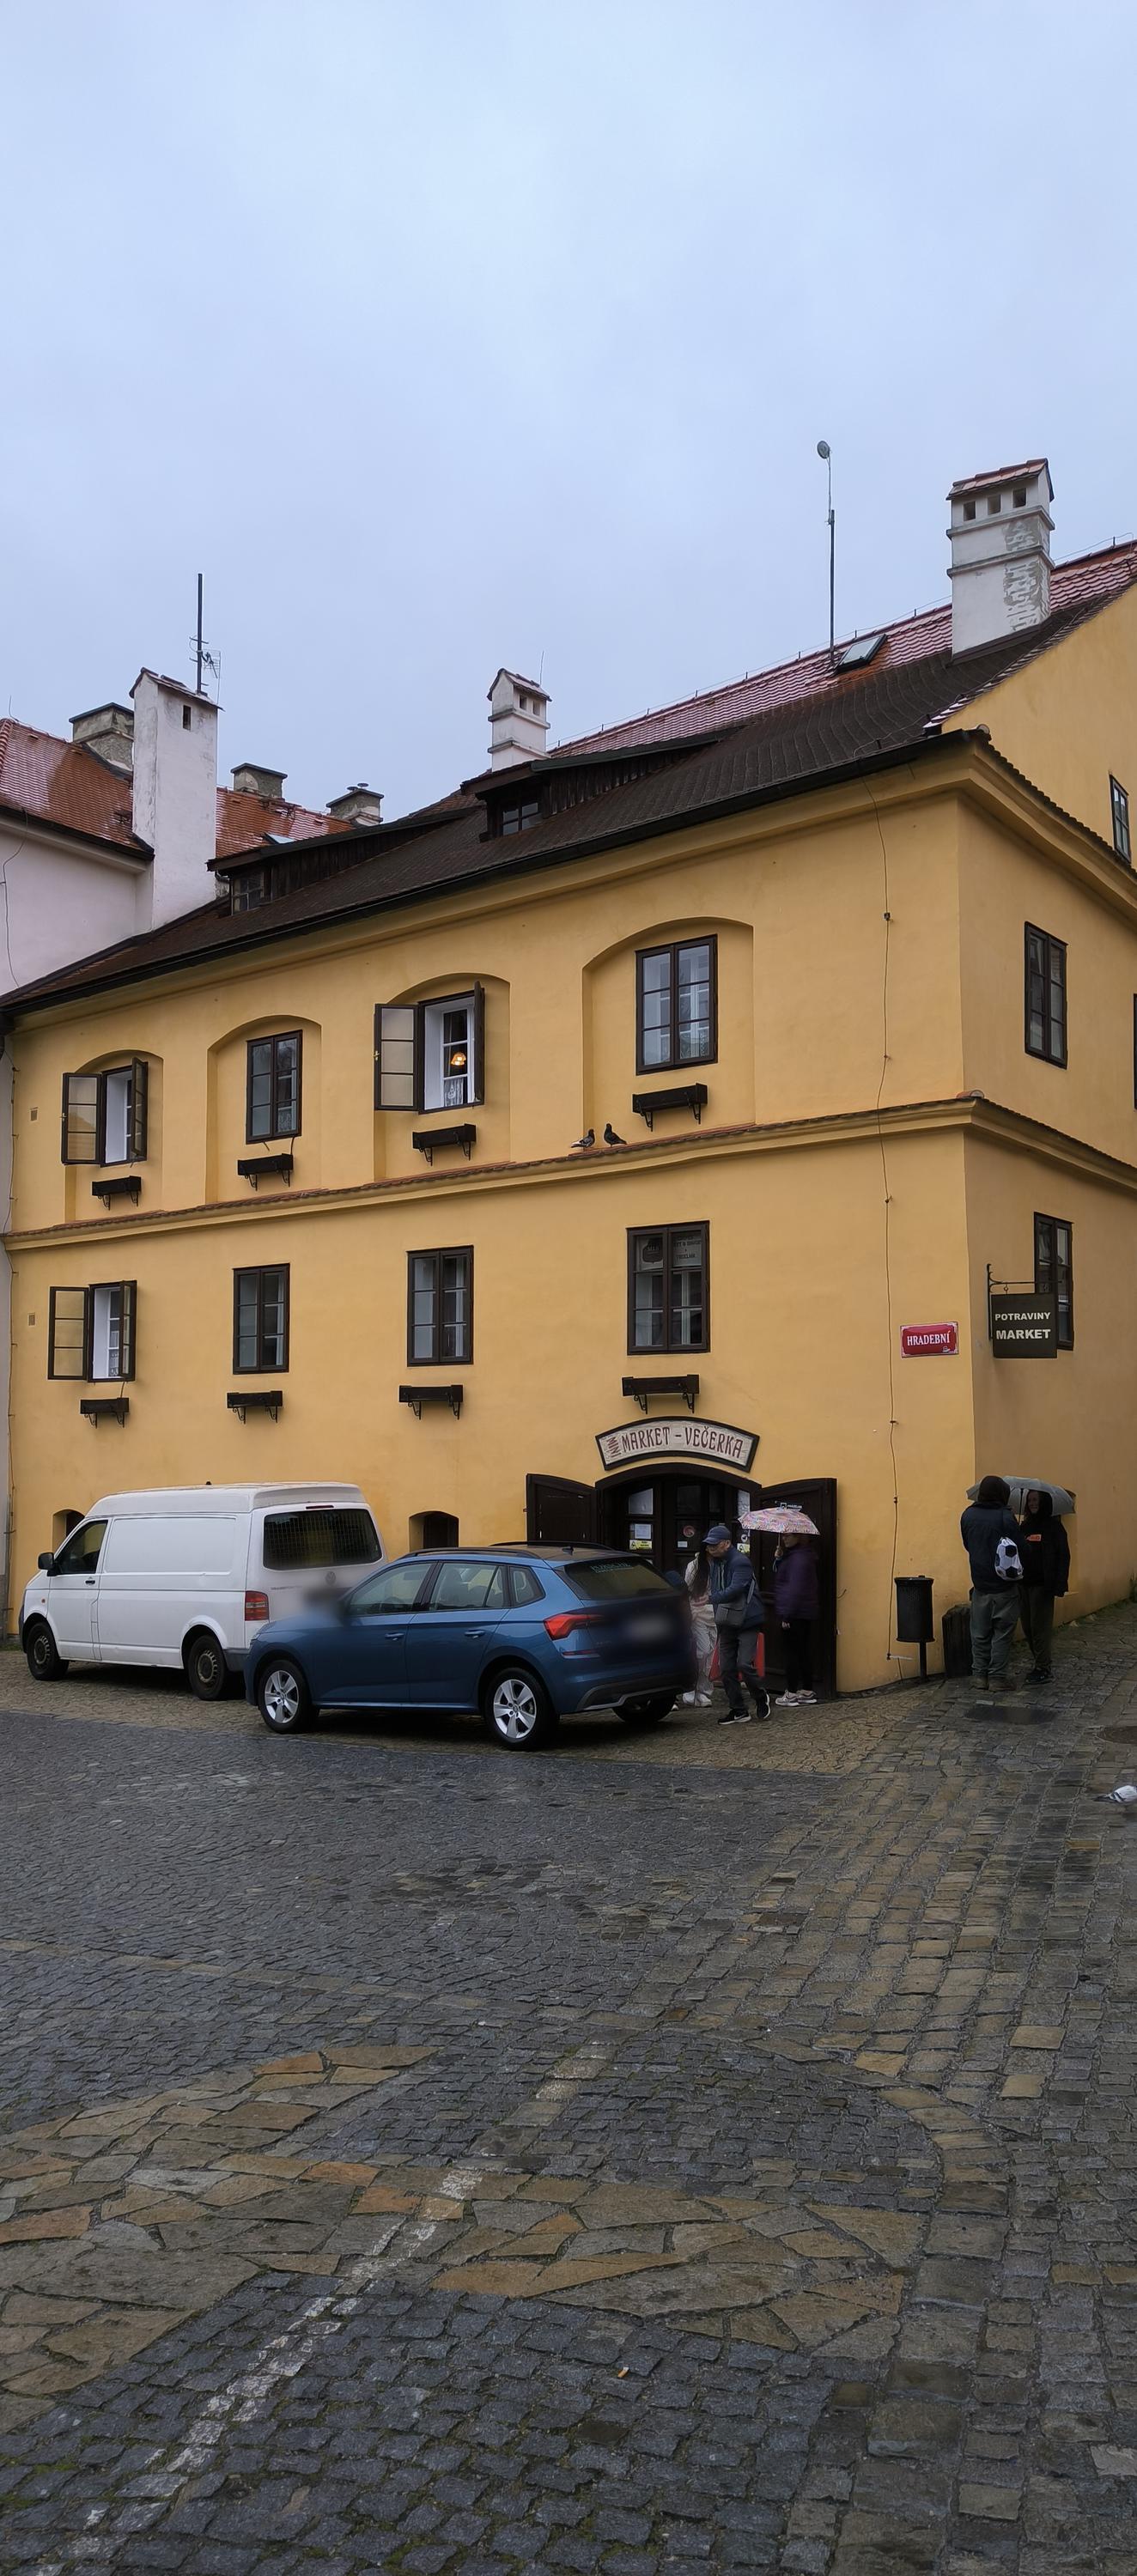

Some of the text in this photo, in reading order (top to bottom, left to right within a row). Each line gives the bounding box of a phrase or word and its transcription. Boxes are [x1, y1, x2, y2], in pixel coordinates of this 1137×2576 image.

[994, 1312, 1051, 1321] POTRAVINY
[907, 1330, 951, 1346] HRADEBNÍ
[995, 1329, 1051, 1340] MARKET
[606, 1437, 622, 1458] MINI
[621, 1426, 670, 1453] MARKET
[684, 1425, 744, 1459] VEČERKA
